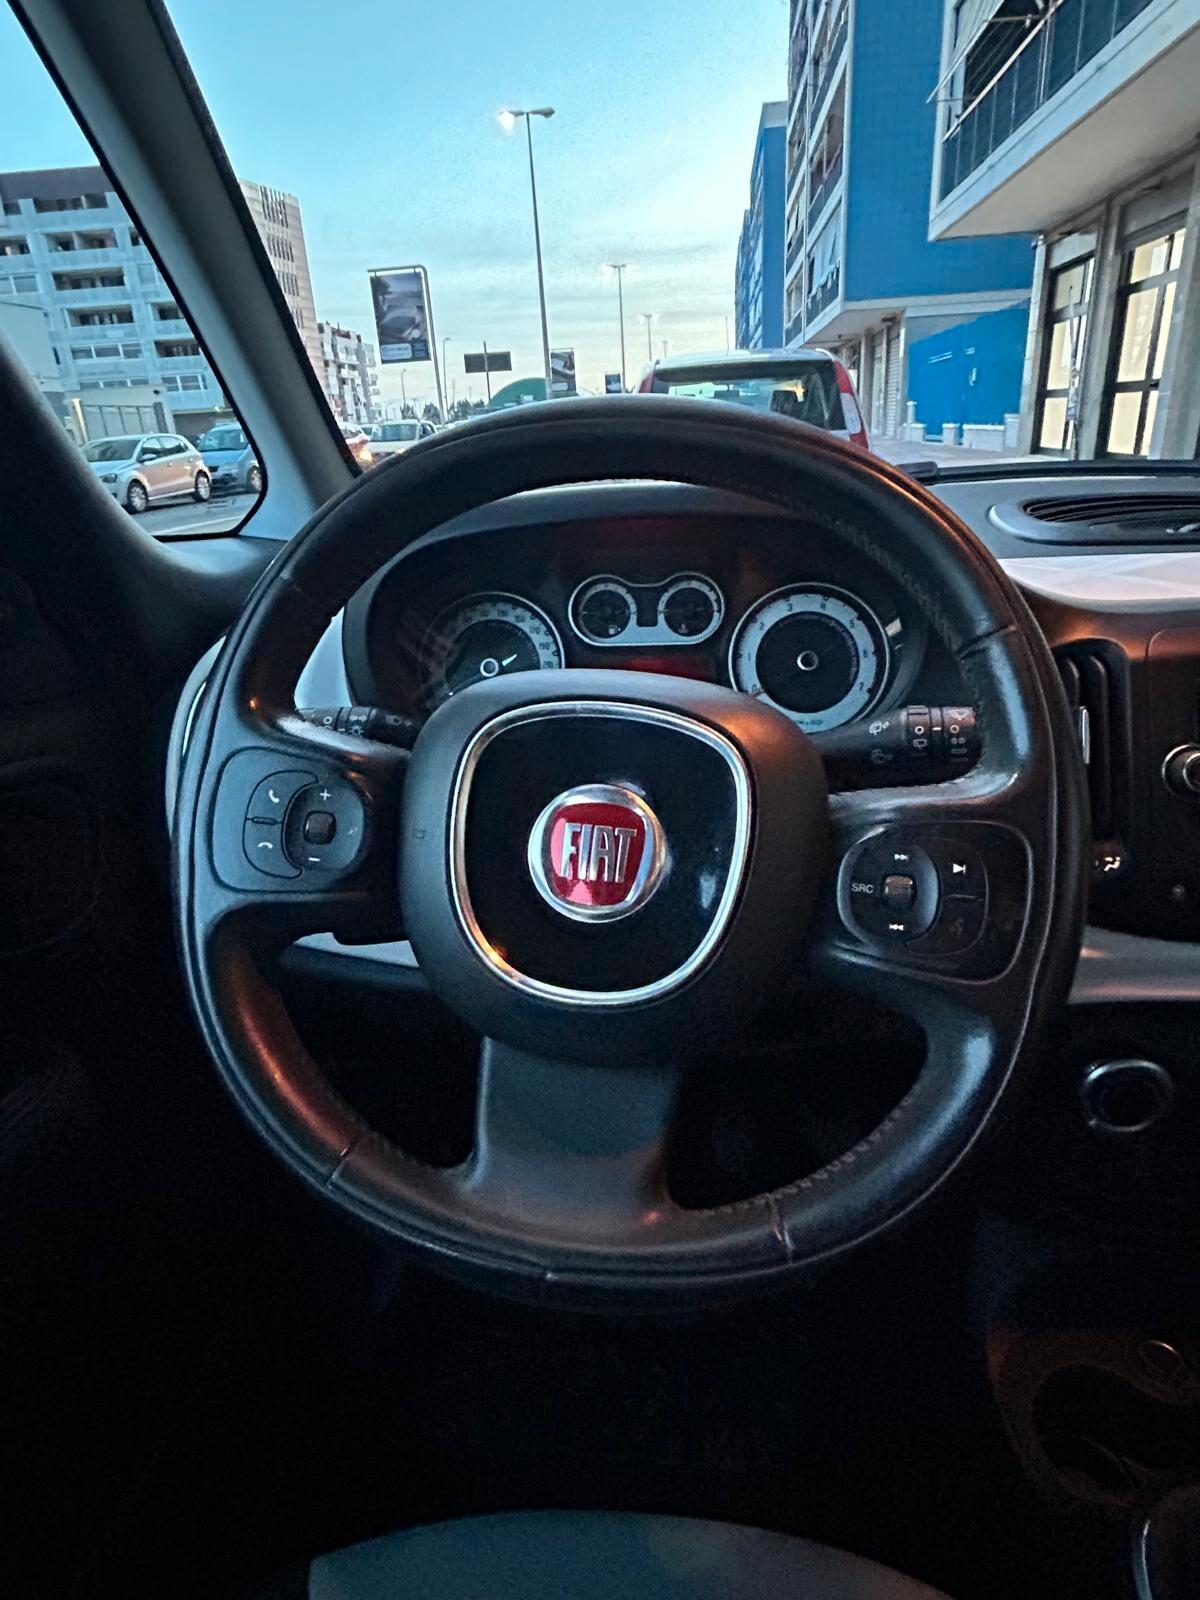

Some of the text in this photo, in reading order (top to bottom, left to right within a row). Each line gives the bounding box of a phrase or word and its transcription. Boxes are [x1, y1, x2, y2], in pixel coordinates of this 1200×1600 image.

[786, 603, 793, 612] 3
[820, 603, 827, 611] 4
[759, 622, 765, 630] 2
[850, 620, 856, 629] 5
[560, 822, 637, 883] FIAT
[851, 882, 874, 894] SRC
